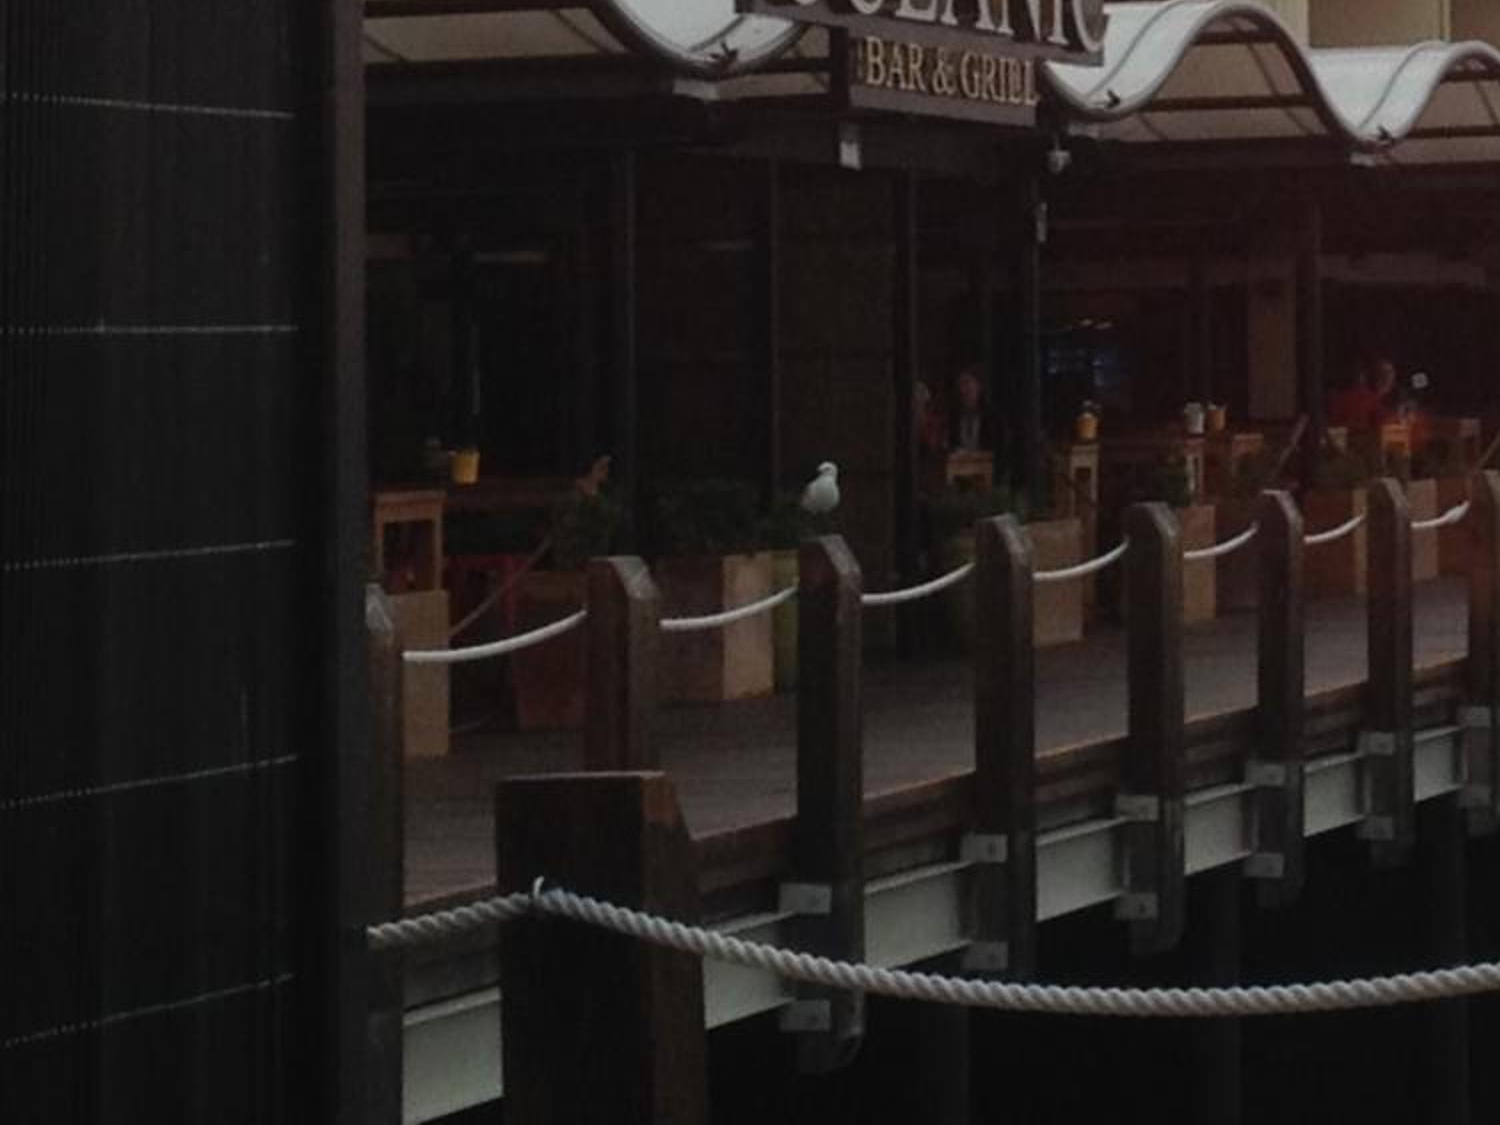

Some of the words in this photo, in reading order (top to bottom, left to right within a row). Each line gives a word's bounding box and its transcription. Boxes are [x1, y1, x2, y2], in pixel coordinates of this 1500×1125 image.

[865, 36, 926, 92] BAR
[931, 47, 956, 95] &
[960, 51, 1040, 106] GRILL
